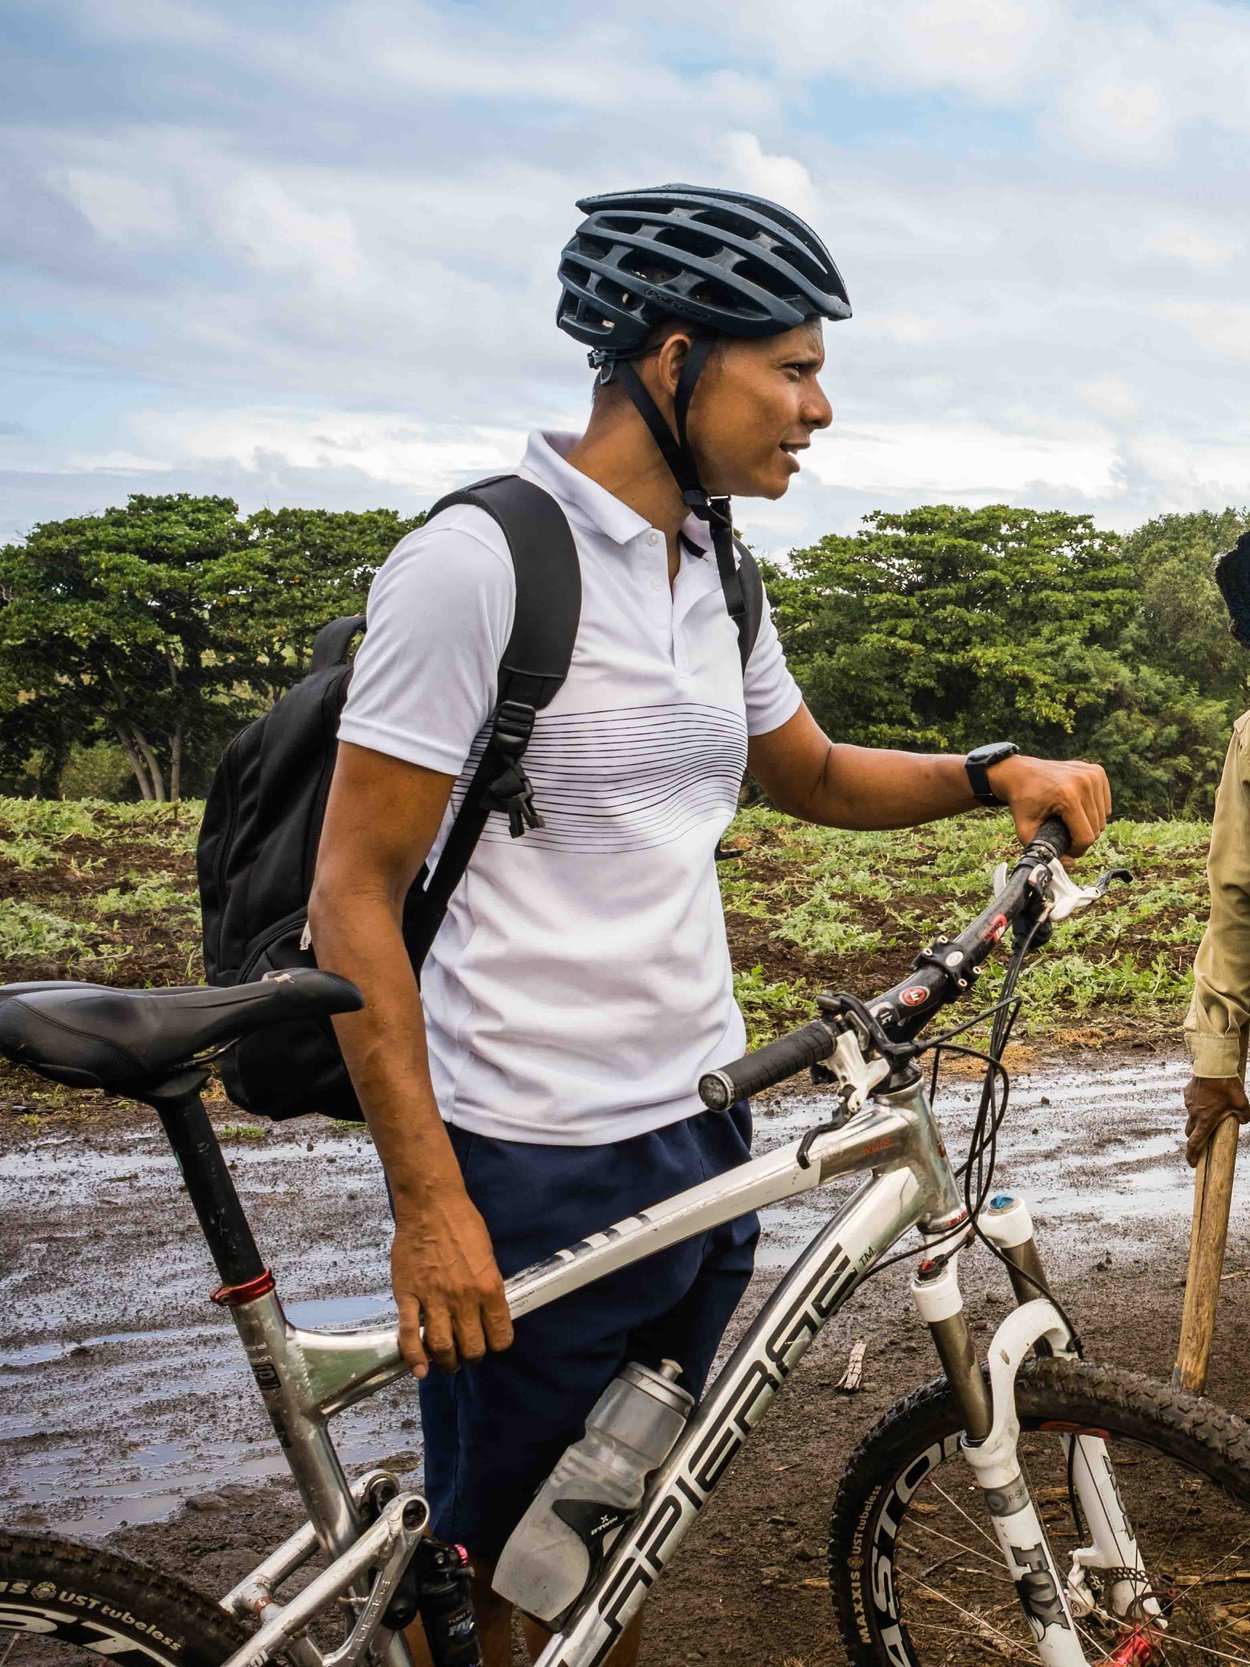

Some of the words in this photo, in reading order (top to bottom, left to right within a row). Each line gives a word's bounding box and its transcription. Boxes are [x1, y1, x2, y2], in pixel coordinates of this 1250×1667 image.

[556, 1242, 859, 1667] LAPIERRE
[856, 1485, 882, 1531] tubeless
[852, 1531, 864, 1555] UST
[850, 1570, 872, 1643] MAXXIS
[1010, 1542, 1071, 1630] FOX
[58, 1590, 101, 1610] UST
[100, 1605, 182, 1651] tubeless
